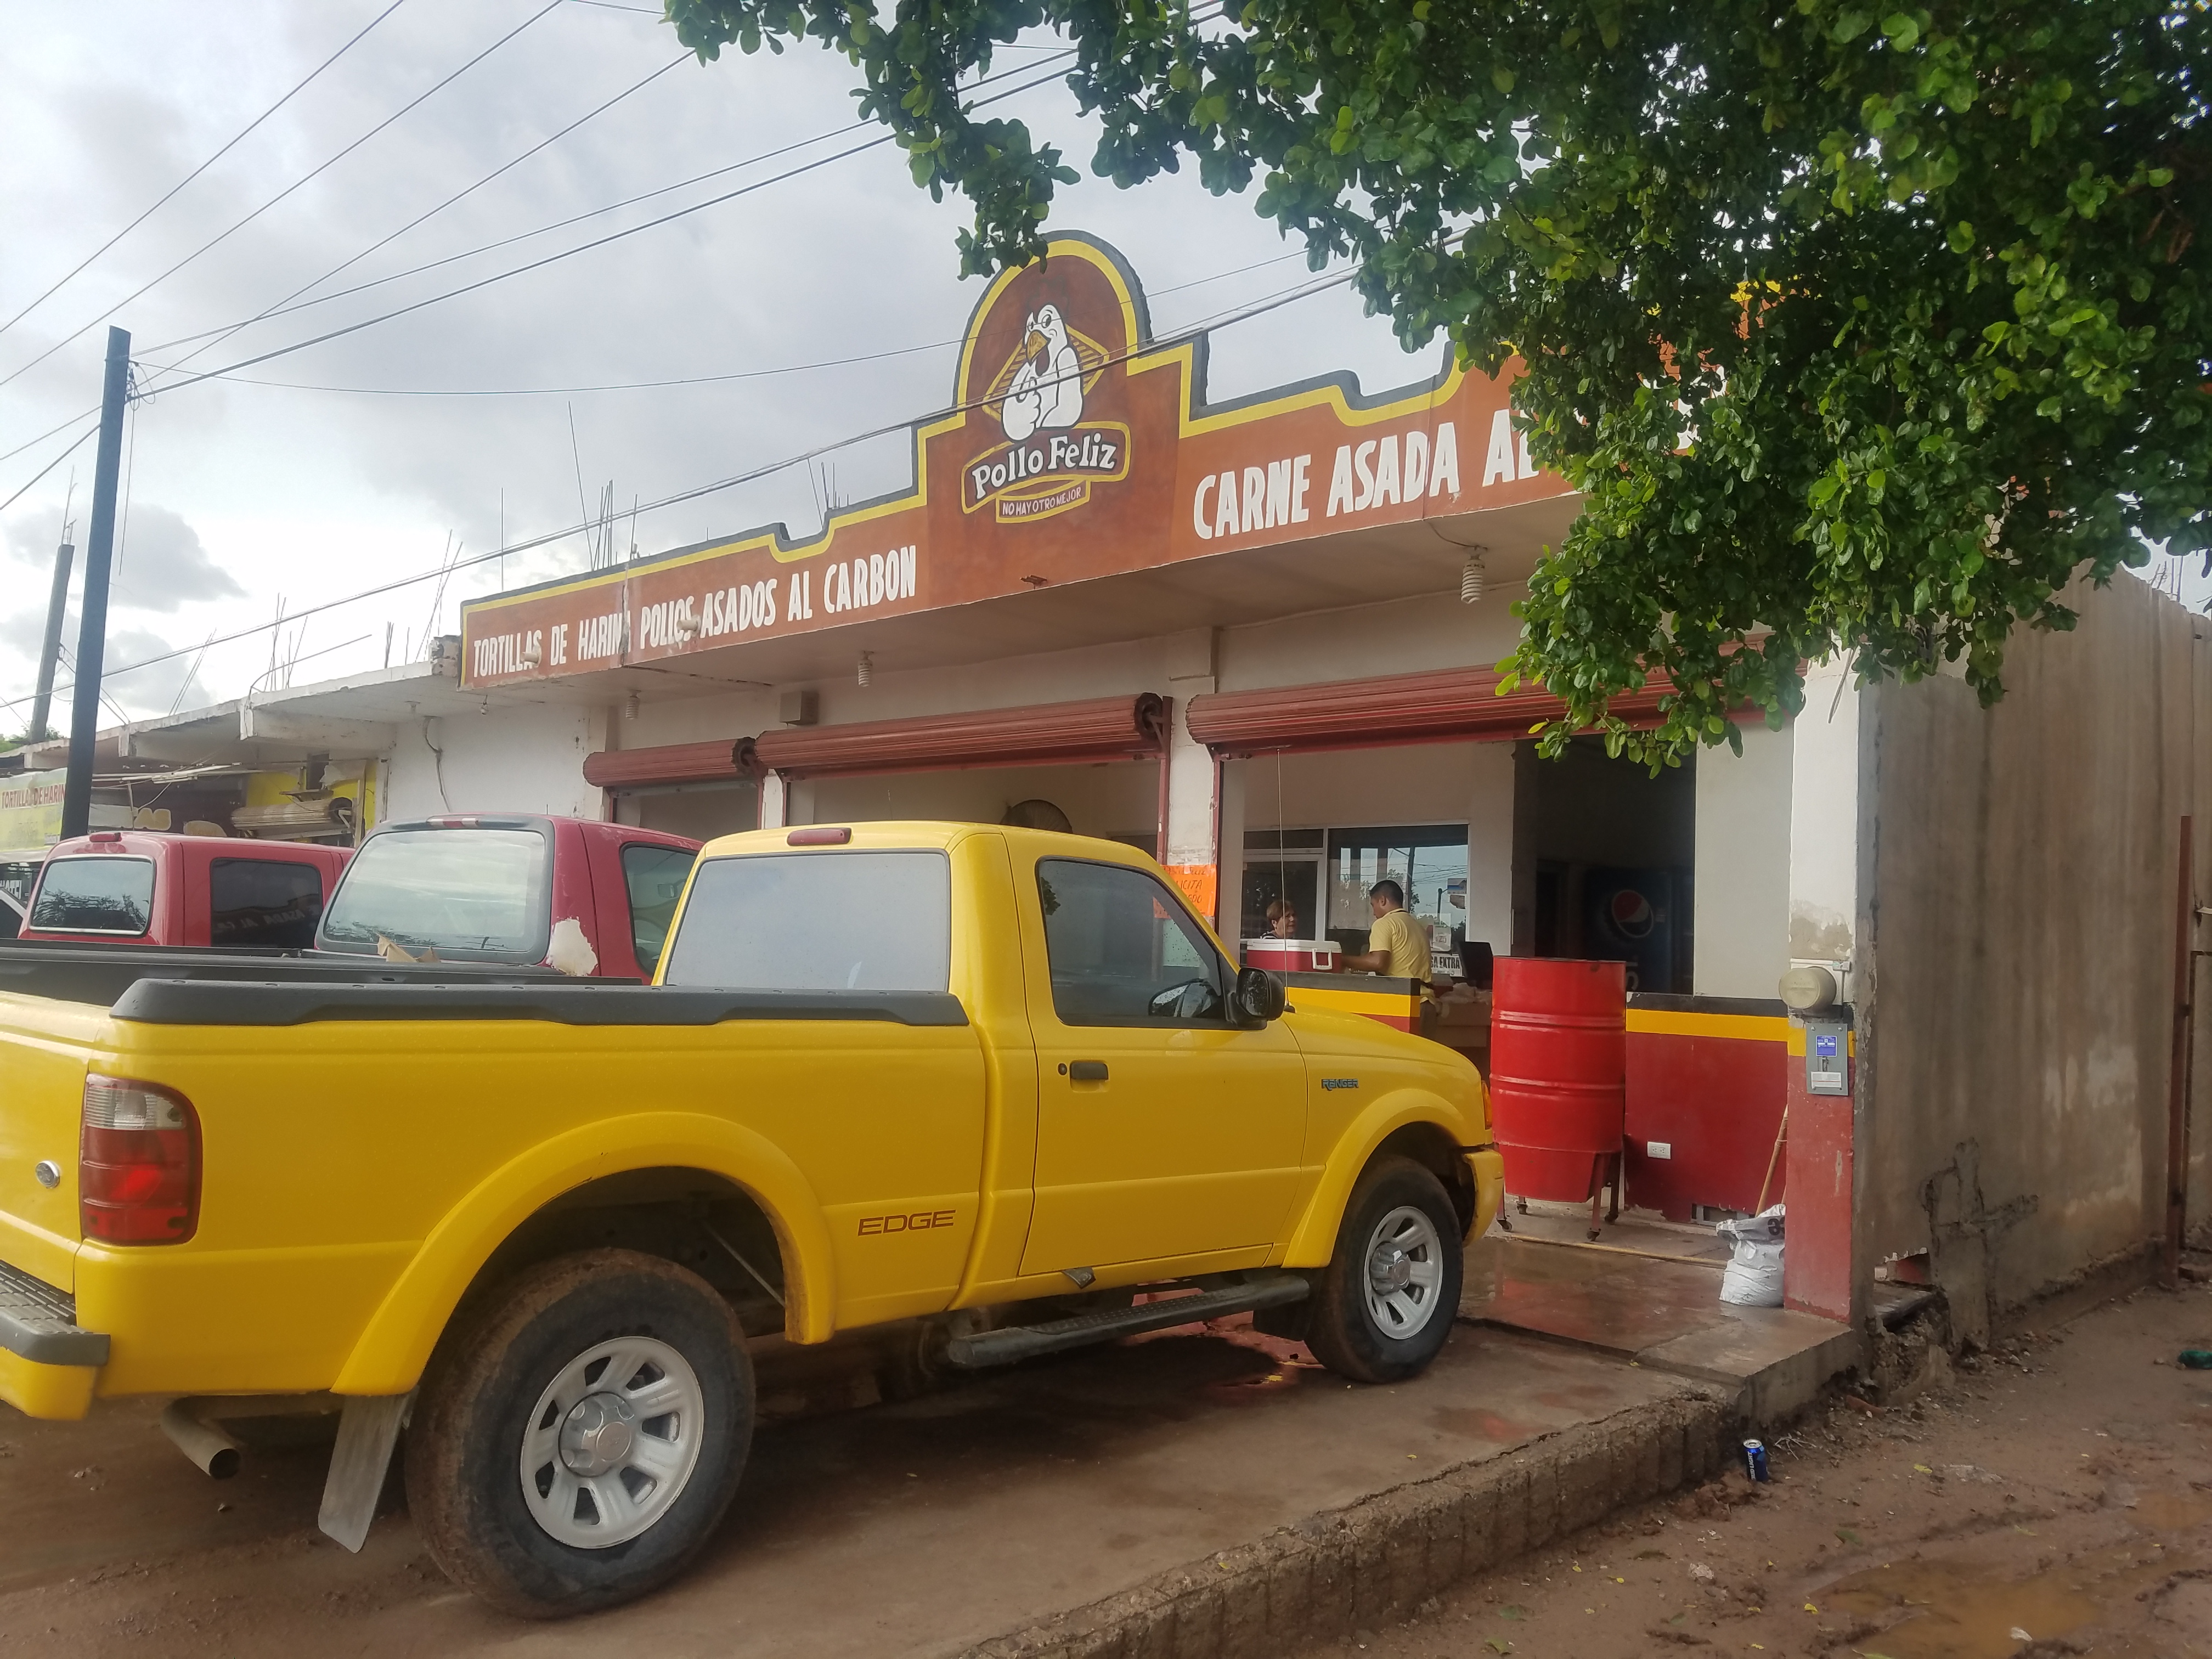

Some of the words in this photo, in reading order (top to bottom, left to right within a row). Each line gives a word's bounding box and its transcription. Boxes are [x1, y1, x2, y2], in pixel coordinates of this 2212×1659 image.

[972, 446, 1043, 499] Pollo
[1047, 432, 1117, 470] Feliz
[1193, 454, 1311, 540] CARNE
[1326, 422, 1460, 517] ASADA
[1482, 408, 1540, 487] AL
[1002, 502, 1015, 516] NO
[1015, 501, 1032, 516] HAY
[1032, 496, 1056, 513] OTRO
[1056, 487, 1081, 506] MEJOR
[473, 629, 542, 678] TORTILLAS
[550, 623, 568, 666] DE
[640, 595, 695, 650] POLLOS
[700, 578, 778, 639] ASADOS
[787, 570, 813, 622] AL
[823, 545, 917, 614] CARBON
[3, 789, 32, 808] TORTILLA
[1440, 957, 1460, 968] EXTRA
[1321, 1079, 1359, 1091] RANGER
[857, 1209, 956, 1237] EDGE
